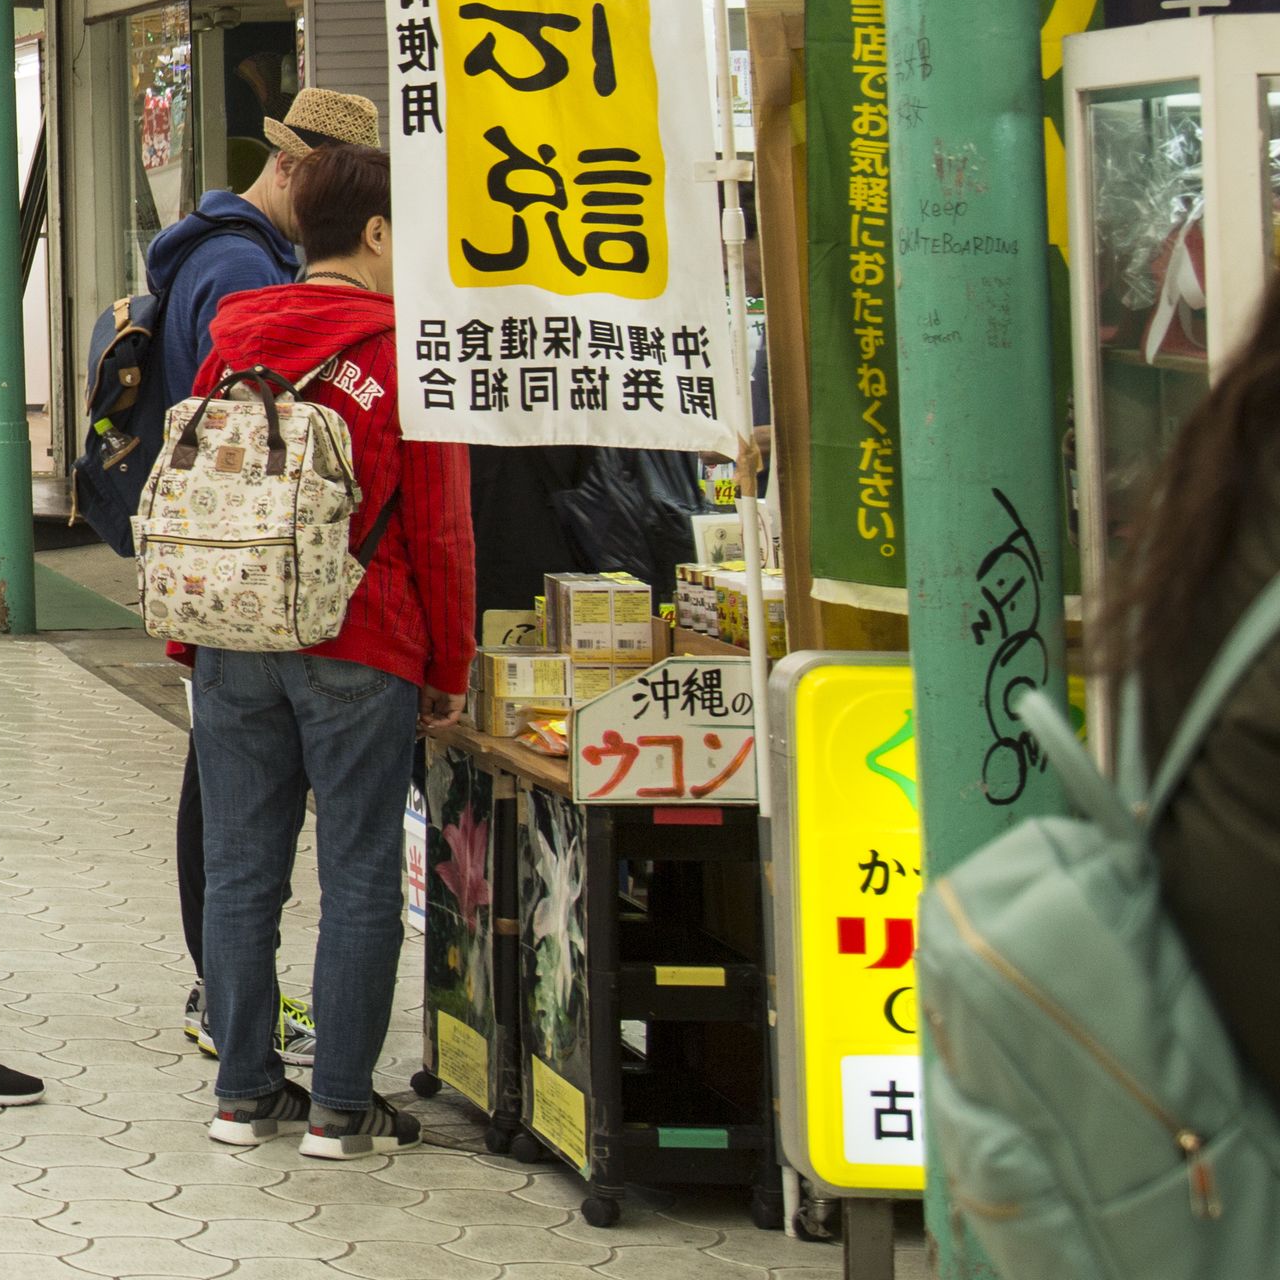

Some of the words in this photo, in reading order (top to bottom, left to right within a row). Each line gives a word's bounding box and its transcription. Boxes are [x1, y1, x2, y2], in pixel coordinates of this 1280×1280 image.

[633, 668, 753, 720] 沖縄の
[581, 730, 755, 799] ウコン
[858, 849, 922, 896] か
